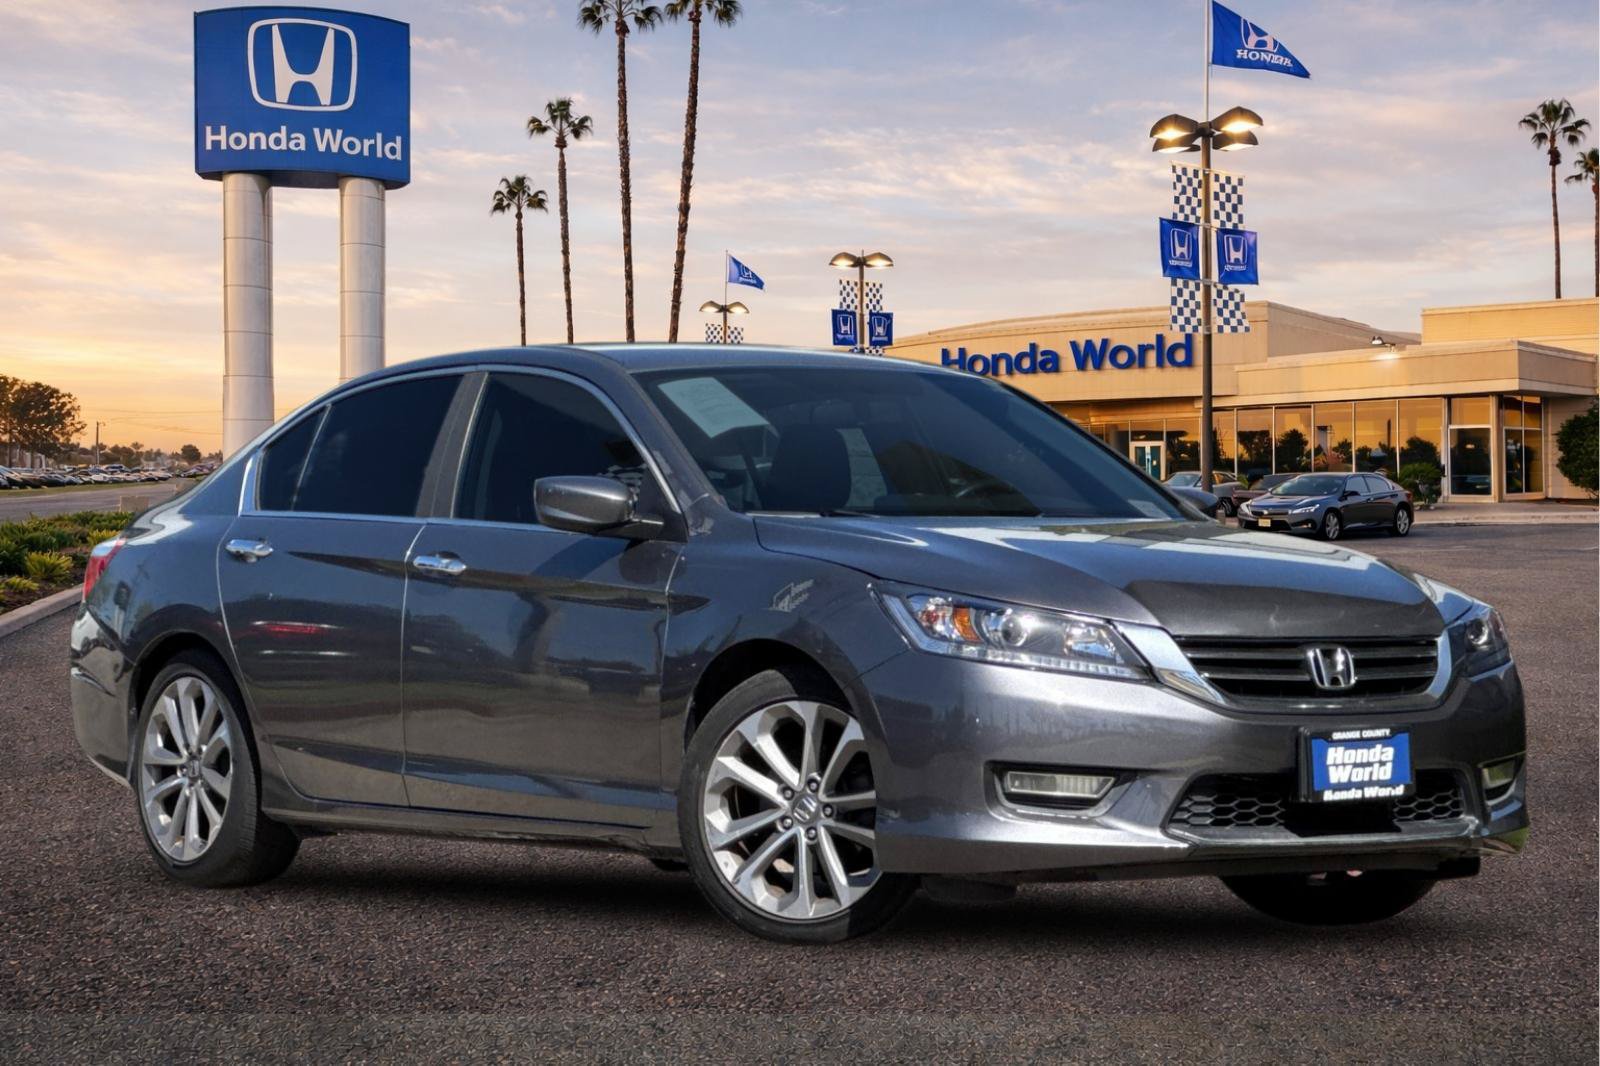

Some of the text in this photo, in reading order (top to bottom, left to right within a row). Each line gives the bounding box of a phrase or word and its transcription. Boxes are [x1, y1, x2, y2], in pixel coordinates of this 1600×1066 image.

[205, 125, 402, 161] Honda World
[941, 333, 1194, 377] Honda World
[1332, 728, 1391, 740] ORANGE COUNTY
[1326, 744, 1394, 765] Honda
[1328, 762, 1393, 784] World
